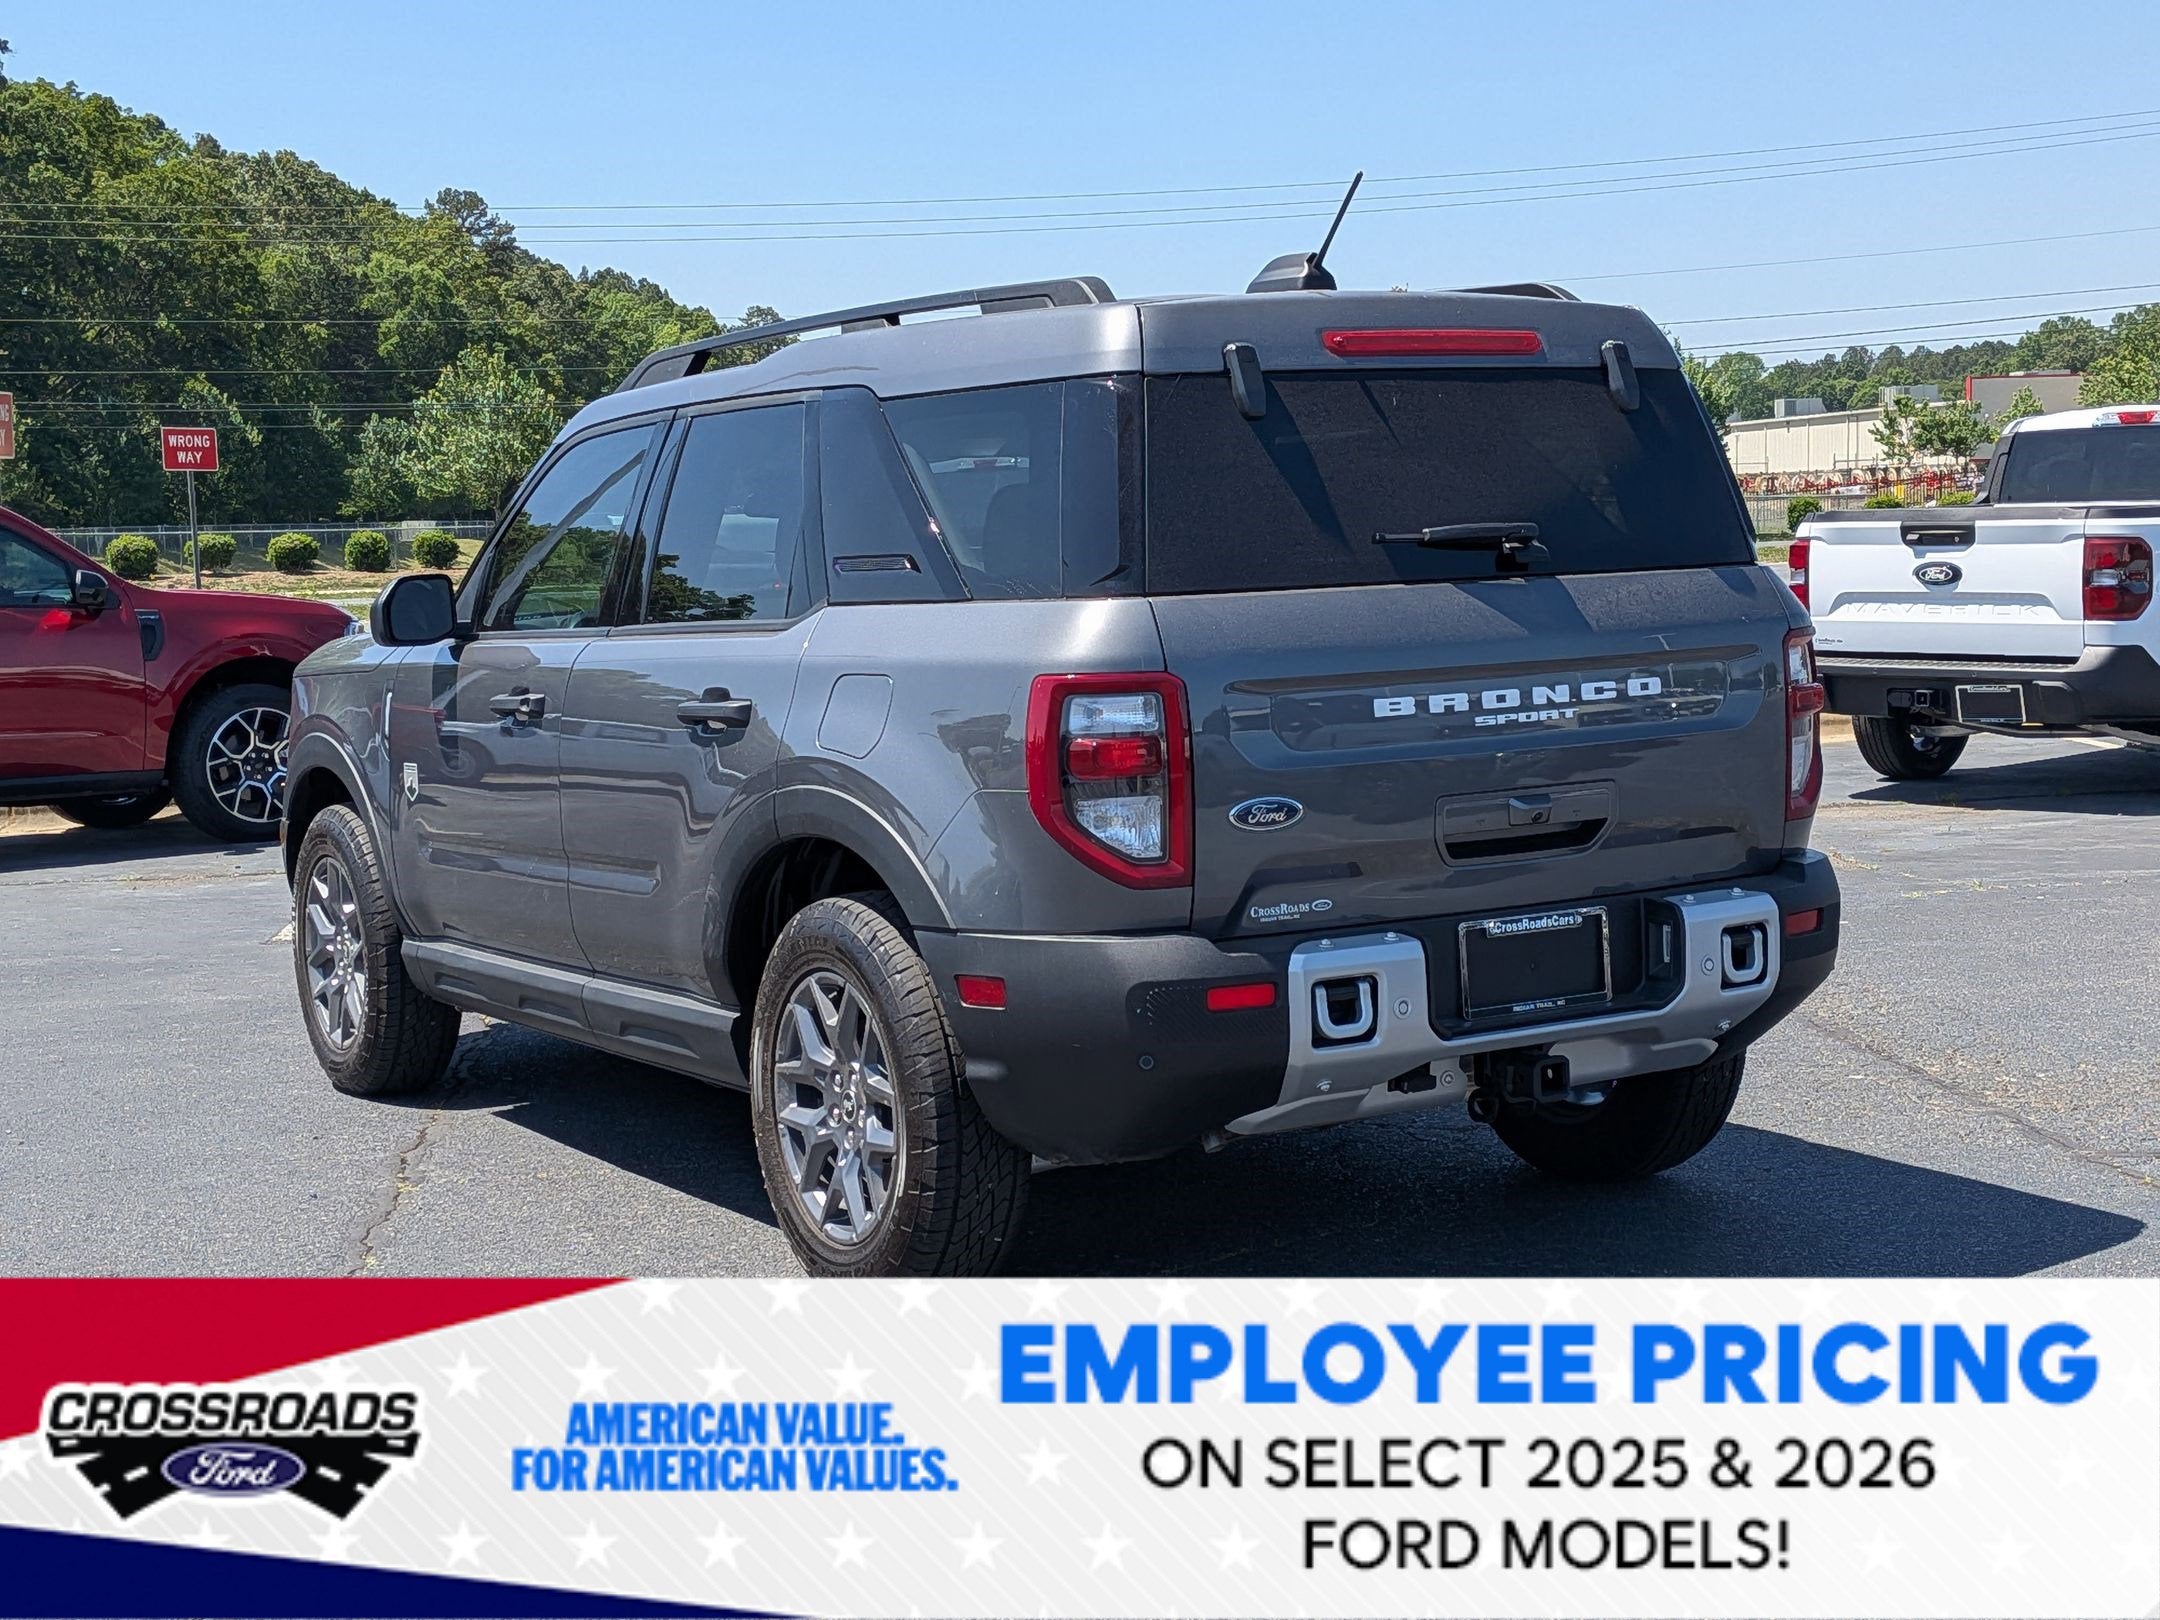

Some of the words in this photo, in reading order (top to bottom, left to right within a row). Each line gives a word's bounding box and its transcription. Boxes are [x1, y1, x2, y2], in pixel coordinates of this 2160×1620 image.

[168, 434, 210, 448] WRONG
[177, 451, 203, 464] WAY
[1848, 603, 2040, 617] MAVERICK
[1373, 677, 1662, 718] BRONCO
[1474, 708, 1579, 727] SPORT
[1248, 804, 1288, 824] Ford
[1494, 915, 1574, 933] CrossRoadsCars
